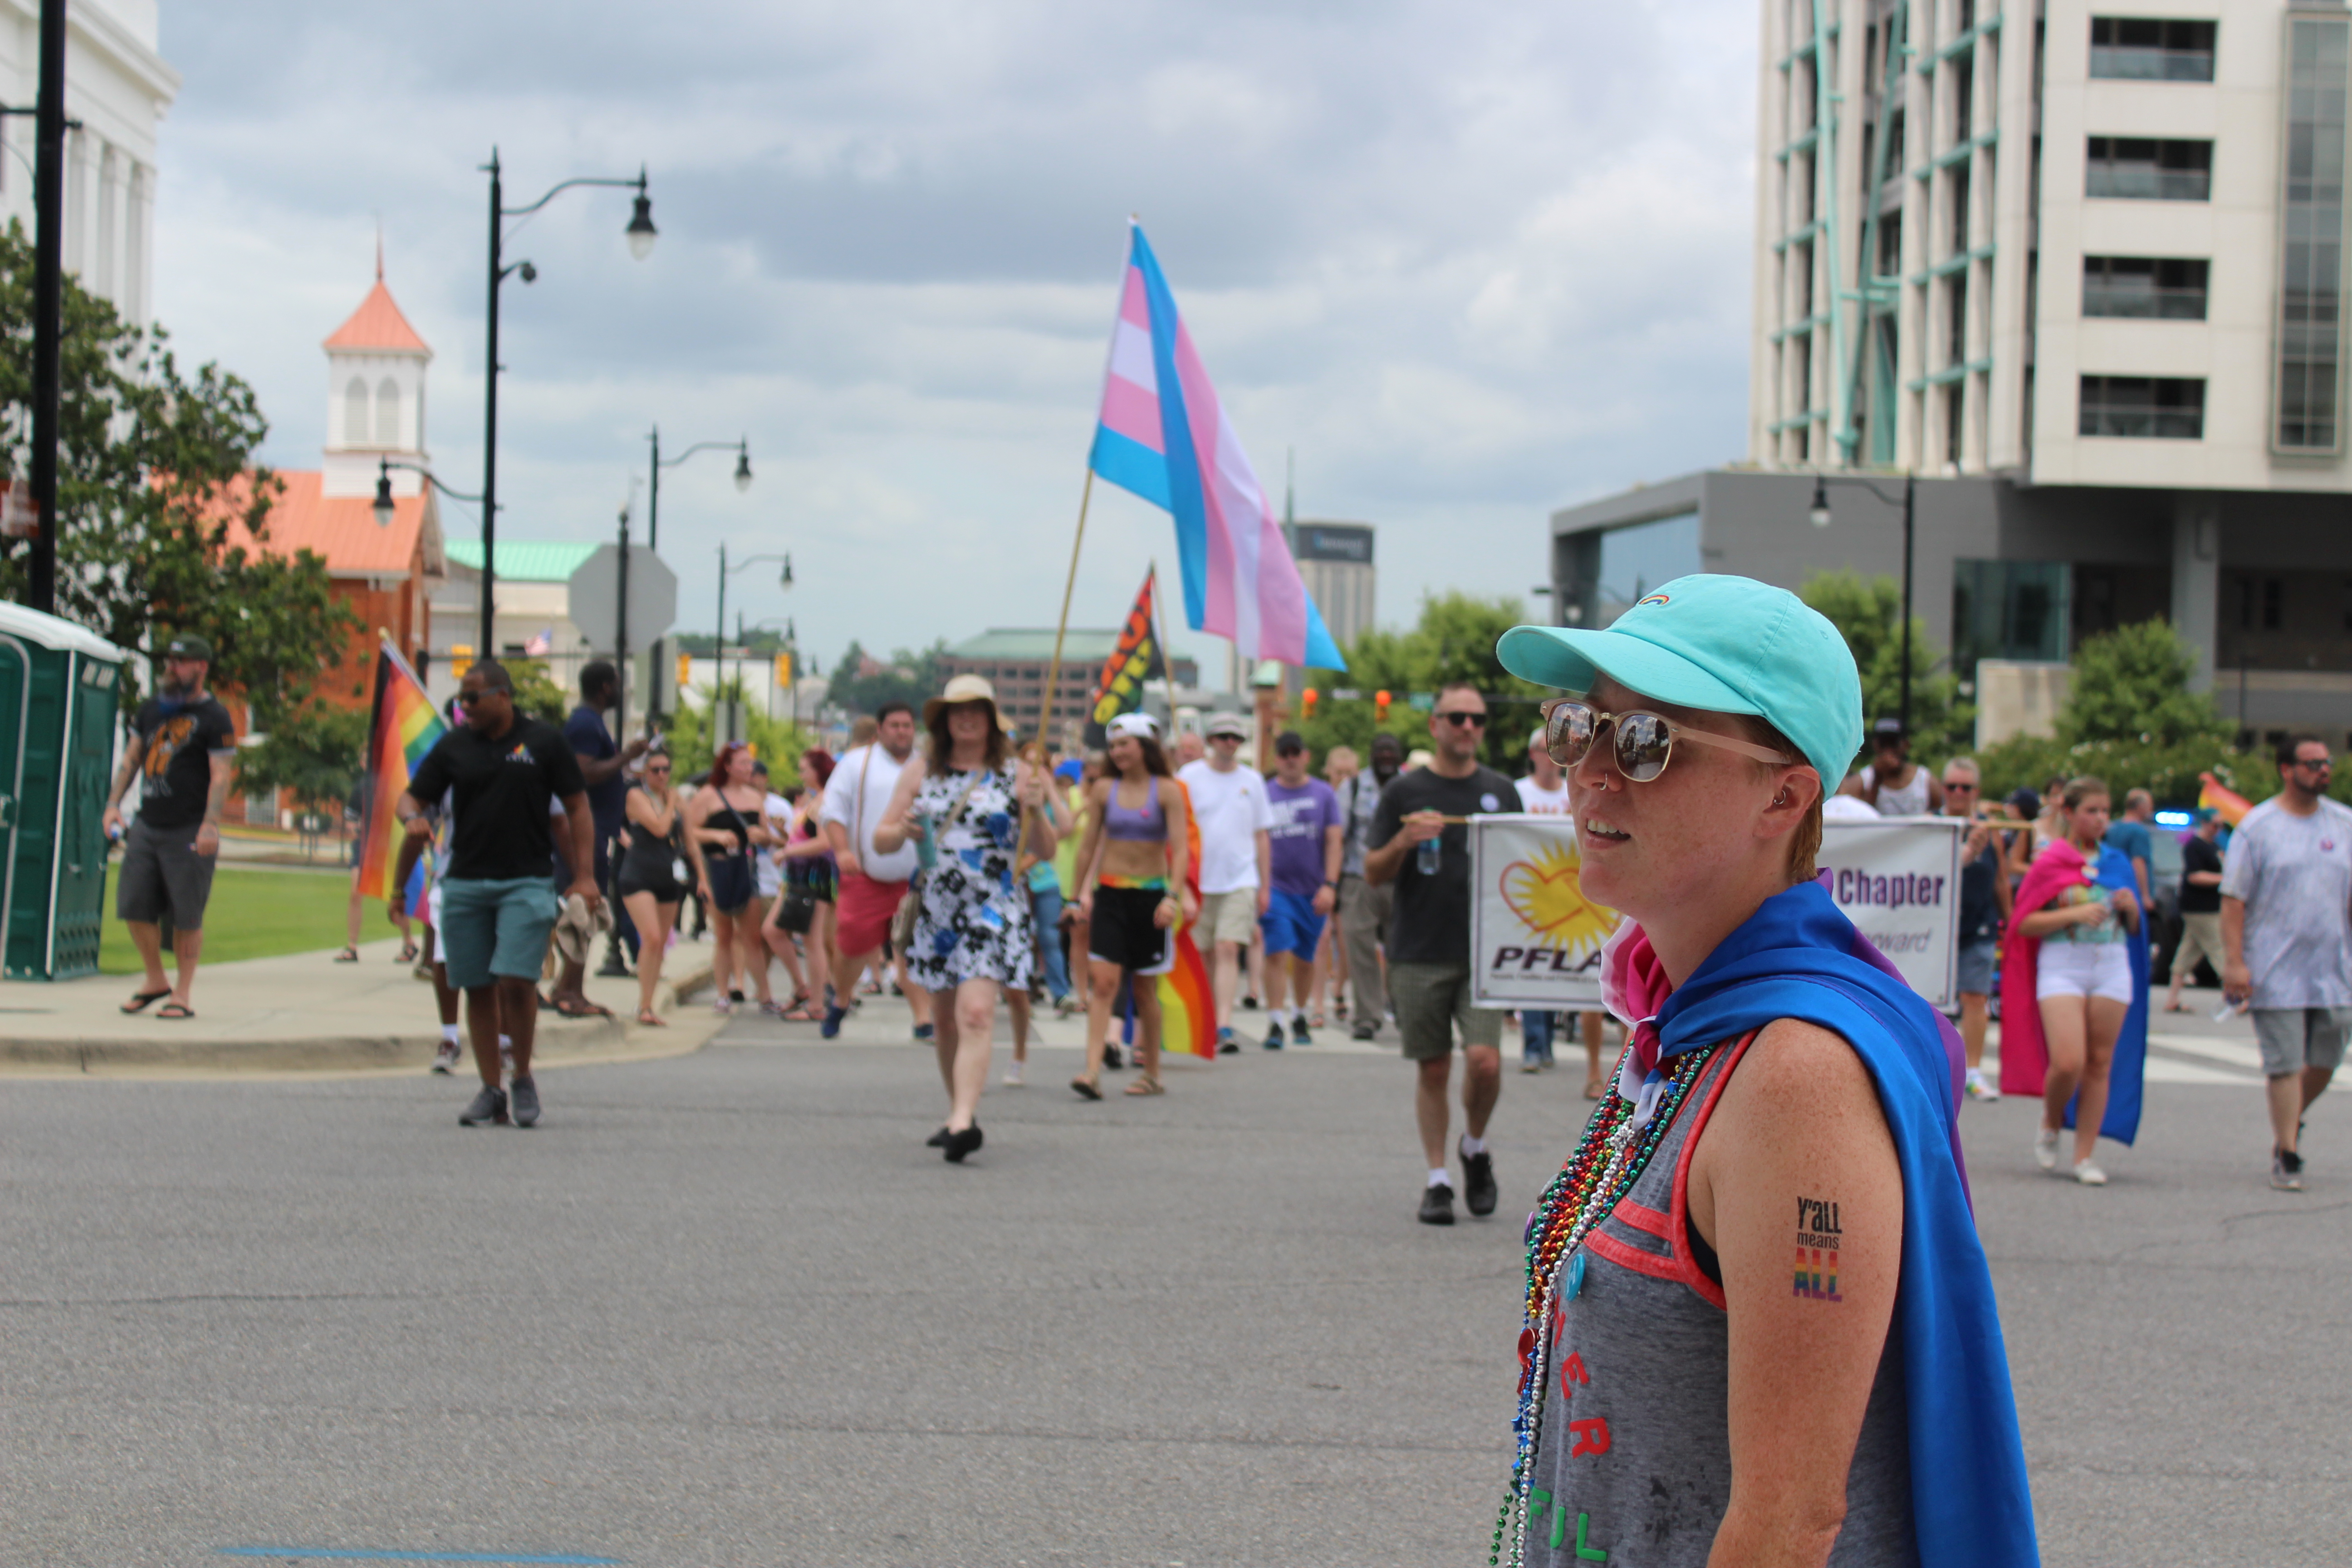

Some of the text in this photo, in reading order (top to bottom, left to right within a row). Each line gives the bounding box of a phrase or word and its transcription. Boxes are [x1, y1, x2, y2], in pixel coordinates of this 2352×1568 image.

[1838, 868, 1944, 910] Chapter
[1797, 1232, 1839, 1250] means
[1793, 1247, 1842, 1302] ALL
